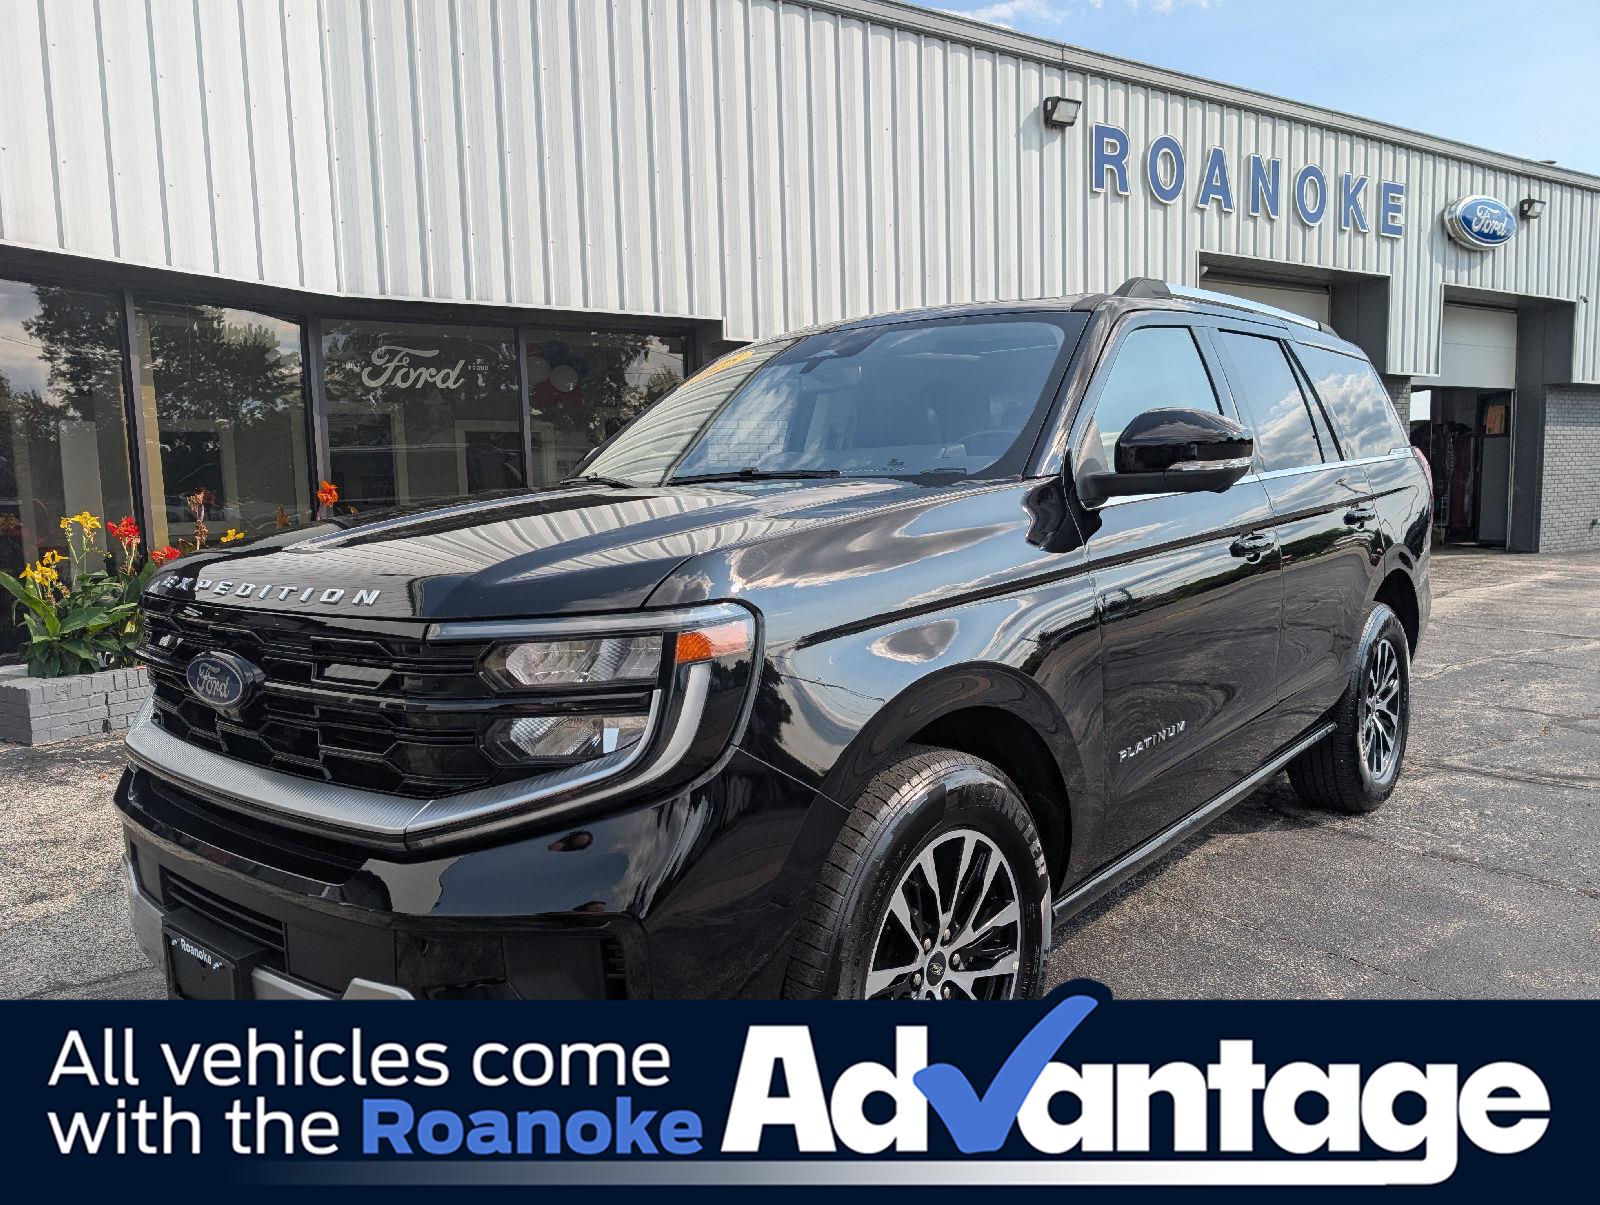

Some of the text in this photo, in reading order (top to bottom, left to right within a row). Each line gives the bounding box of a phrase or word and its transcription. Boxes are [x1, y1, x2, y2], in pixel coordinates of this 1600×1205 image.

[1092, 122, 1406, 239] ROANOKE
[1471, 204, 1508, 237] Ford
[361, 345, 466, 389] Ford
[161, 575, 381, 606] EXPEDITION
[196, 662, 230, 699] Ford
[1118, 720, 1186, 763] PLATINUM
[180, 938, 212, 965] Roanoke
